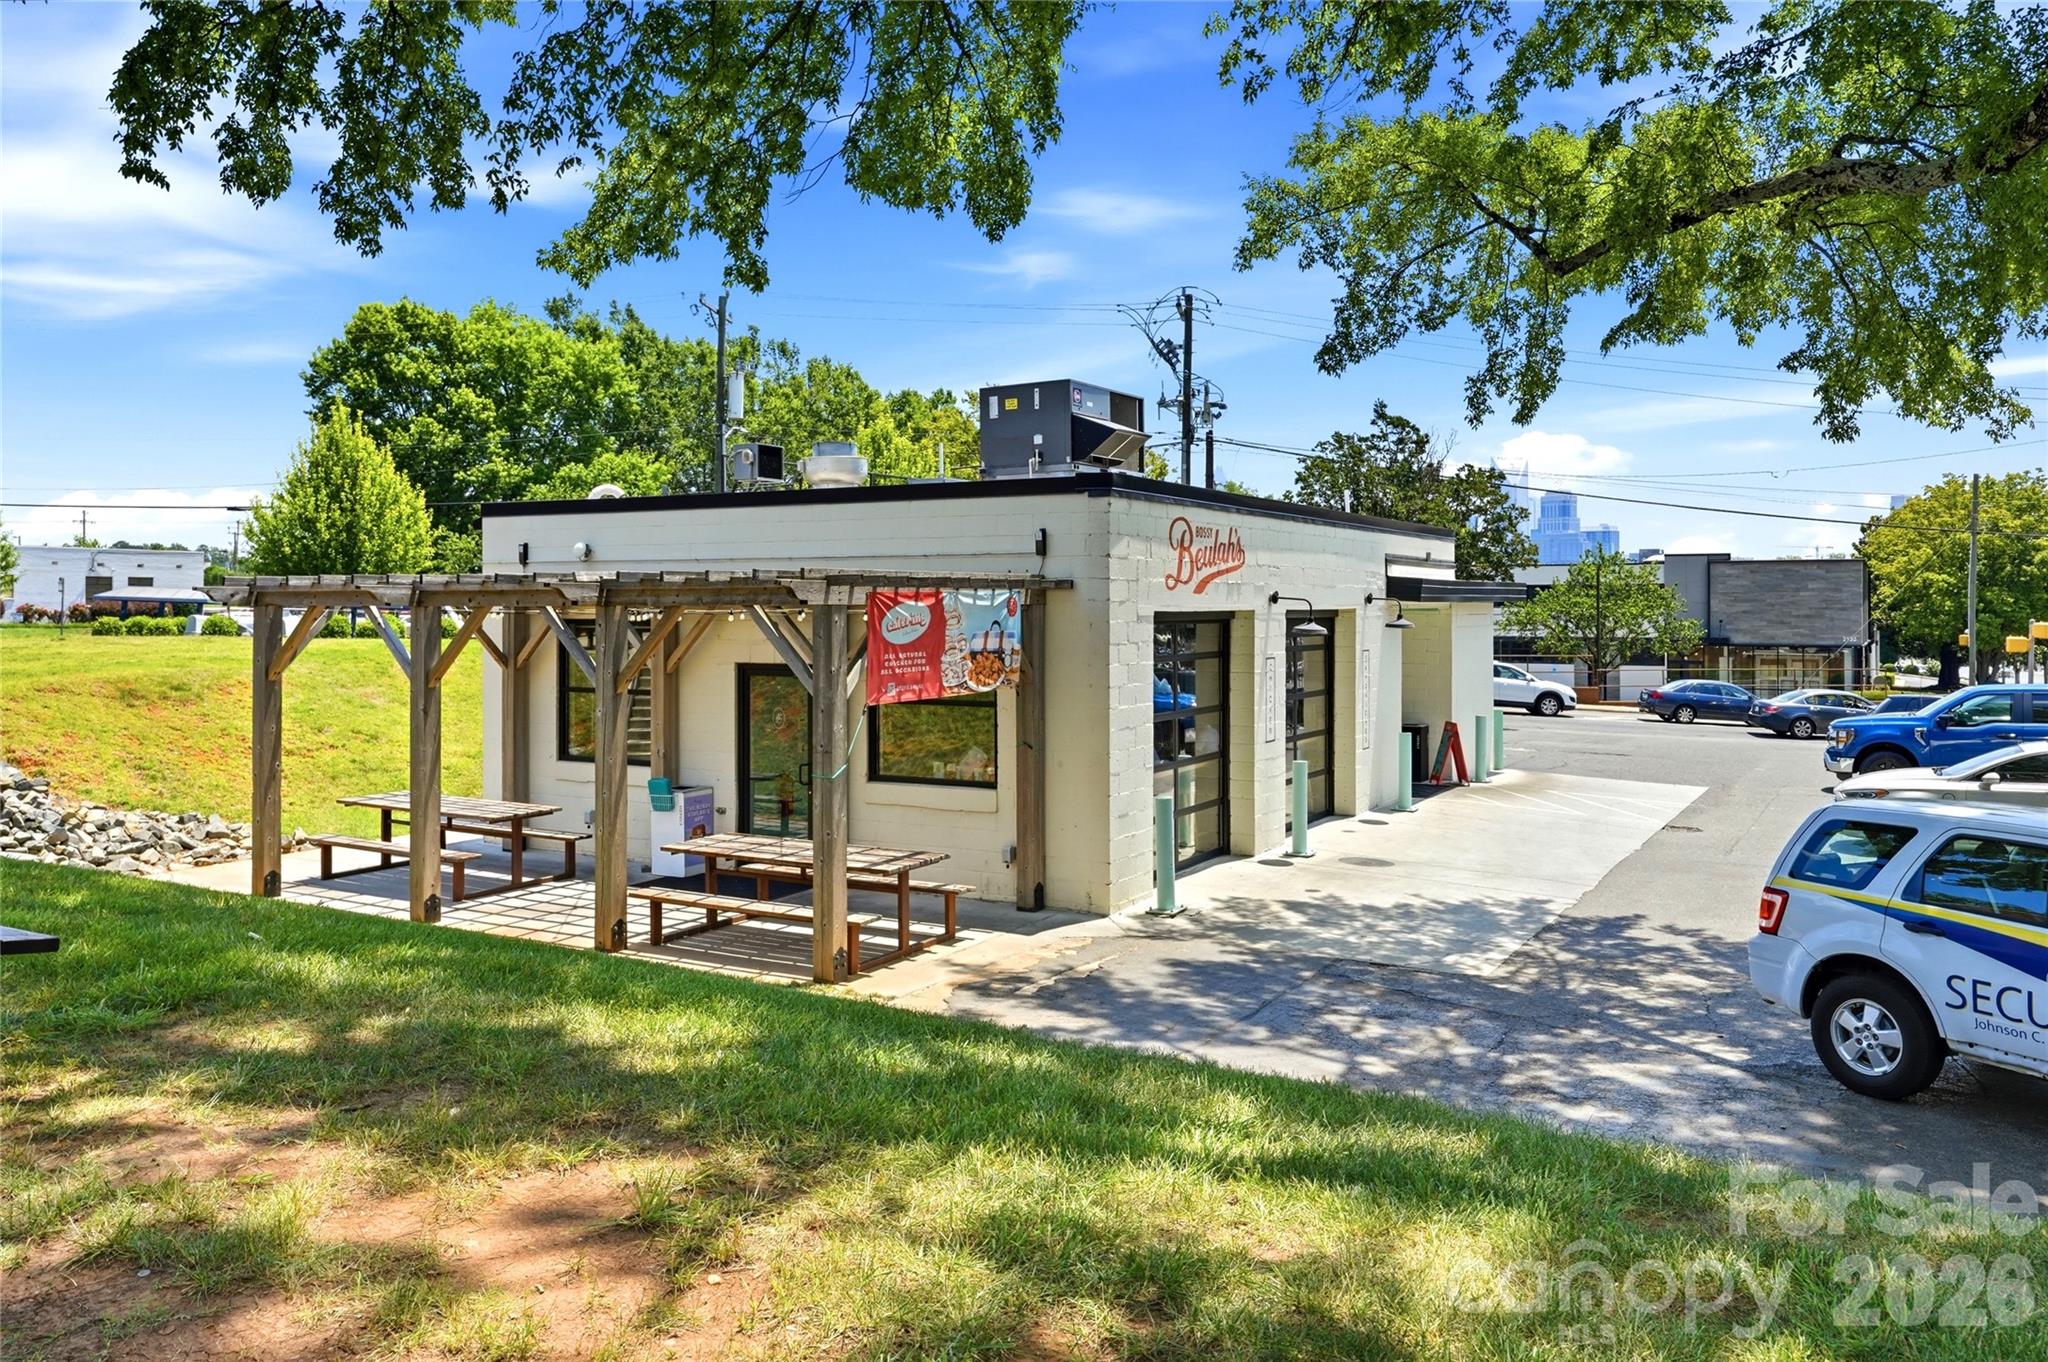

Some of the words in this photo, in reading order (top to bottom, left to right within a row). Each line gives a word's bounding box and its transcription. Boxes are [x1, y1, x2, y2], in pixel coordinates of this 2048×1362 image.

[1195, 526, 1214, 539] BOSSY
[1165, 516, 1246, 594] Beulah's
[1945, 974, 2048, 1029] SECU
[1974, 1017, 2028, 1039] Johnson
[2031, 1031, 2045, 1044] C.
